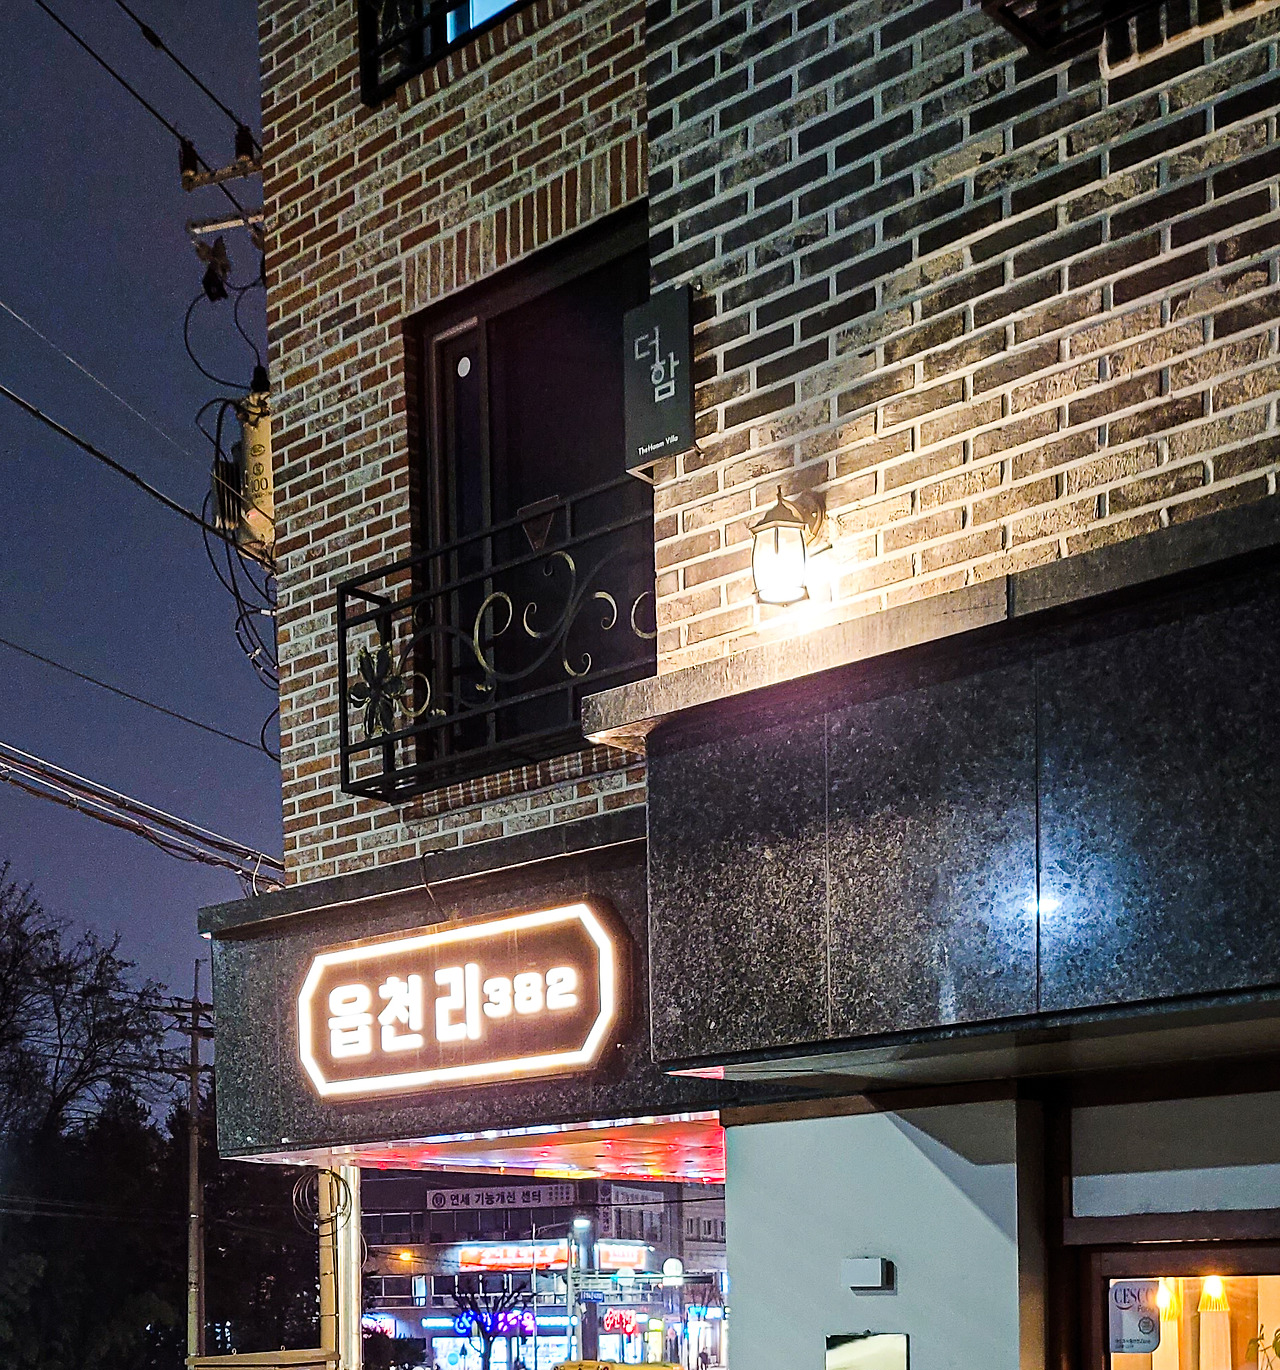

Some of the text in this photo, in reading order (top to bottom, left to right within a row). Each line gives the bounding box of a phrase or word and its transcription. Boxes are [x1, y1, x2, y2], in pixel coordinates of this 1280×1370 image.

[634, 326, 680, 403] 더함
[450, 1192, 470, 1206] 연세
[521, 1189, 541, 1204] 센터
